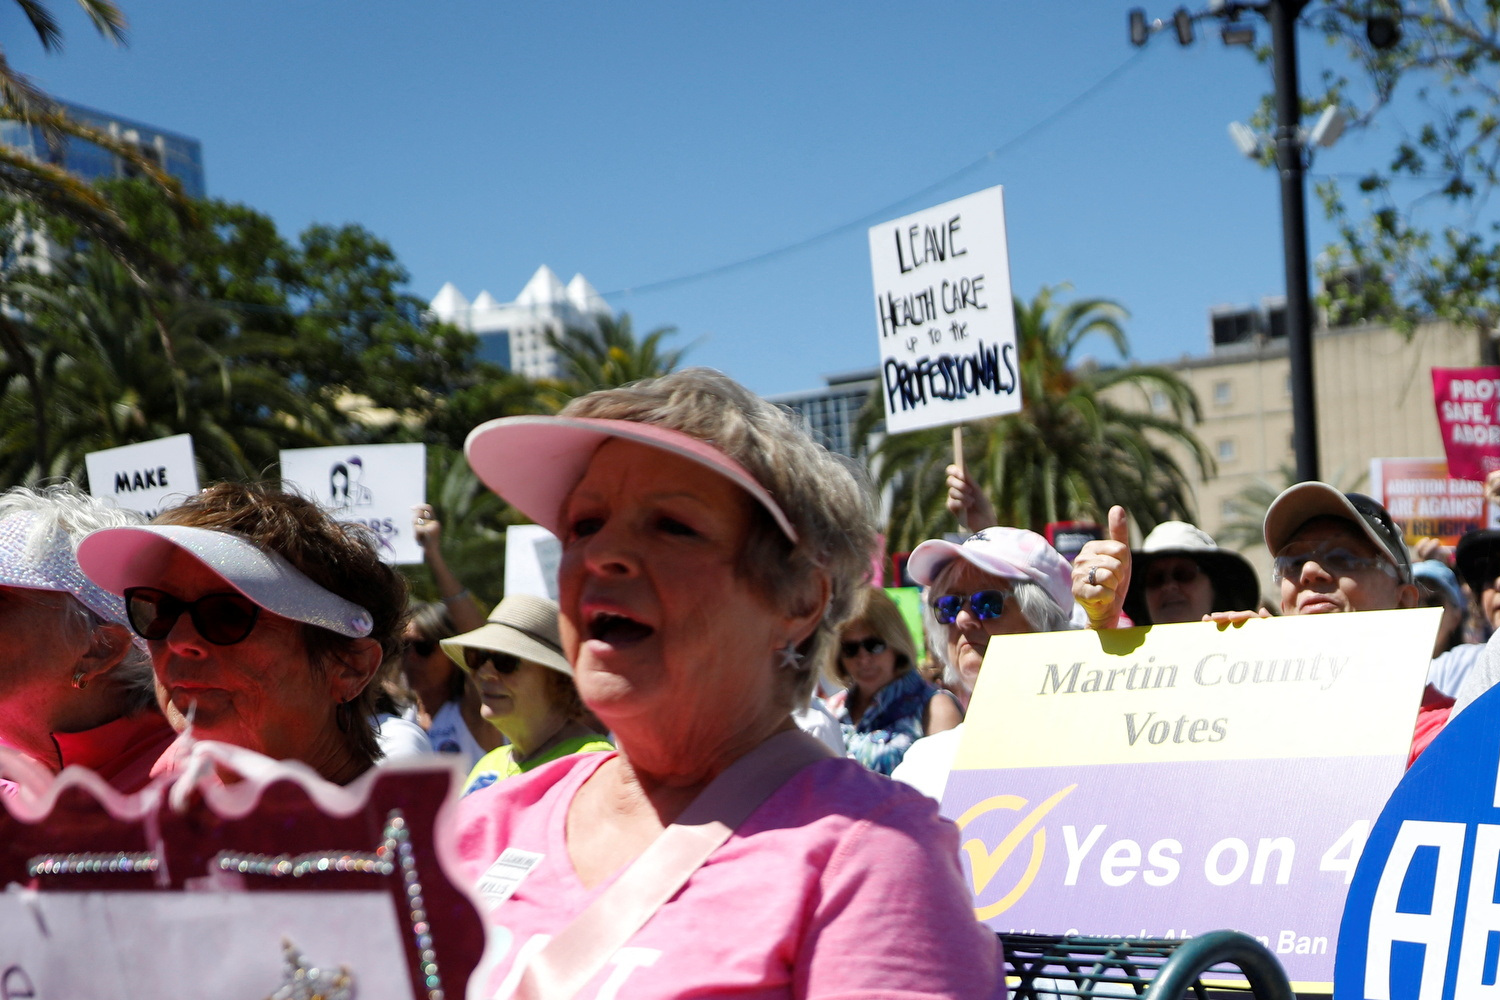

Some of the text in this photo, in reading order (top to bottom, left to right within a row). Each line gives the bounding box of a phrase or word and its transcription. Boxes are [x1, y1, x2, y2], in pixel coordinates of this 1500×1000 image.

[895, 213, 967, 274] LEAVE
[879, 274, 988, 338] HEALTH CARE
[884, 338, 1016, 415] PROFESSIONALS
[1442, 401, 1491, 425] SAFE,
[114, 466, 169, 494] MAKE
[1036, 649, 1351, 697] Martin County
[1122, 711, 1230, 747] Votes
[1060, 818, 1370, 887] Yes on 4
[1275, 928, 1329, 955] Ban
